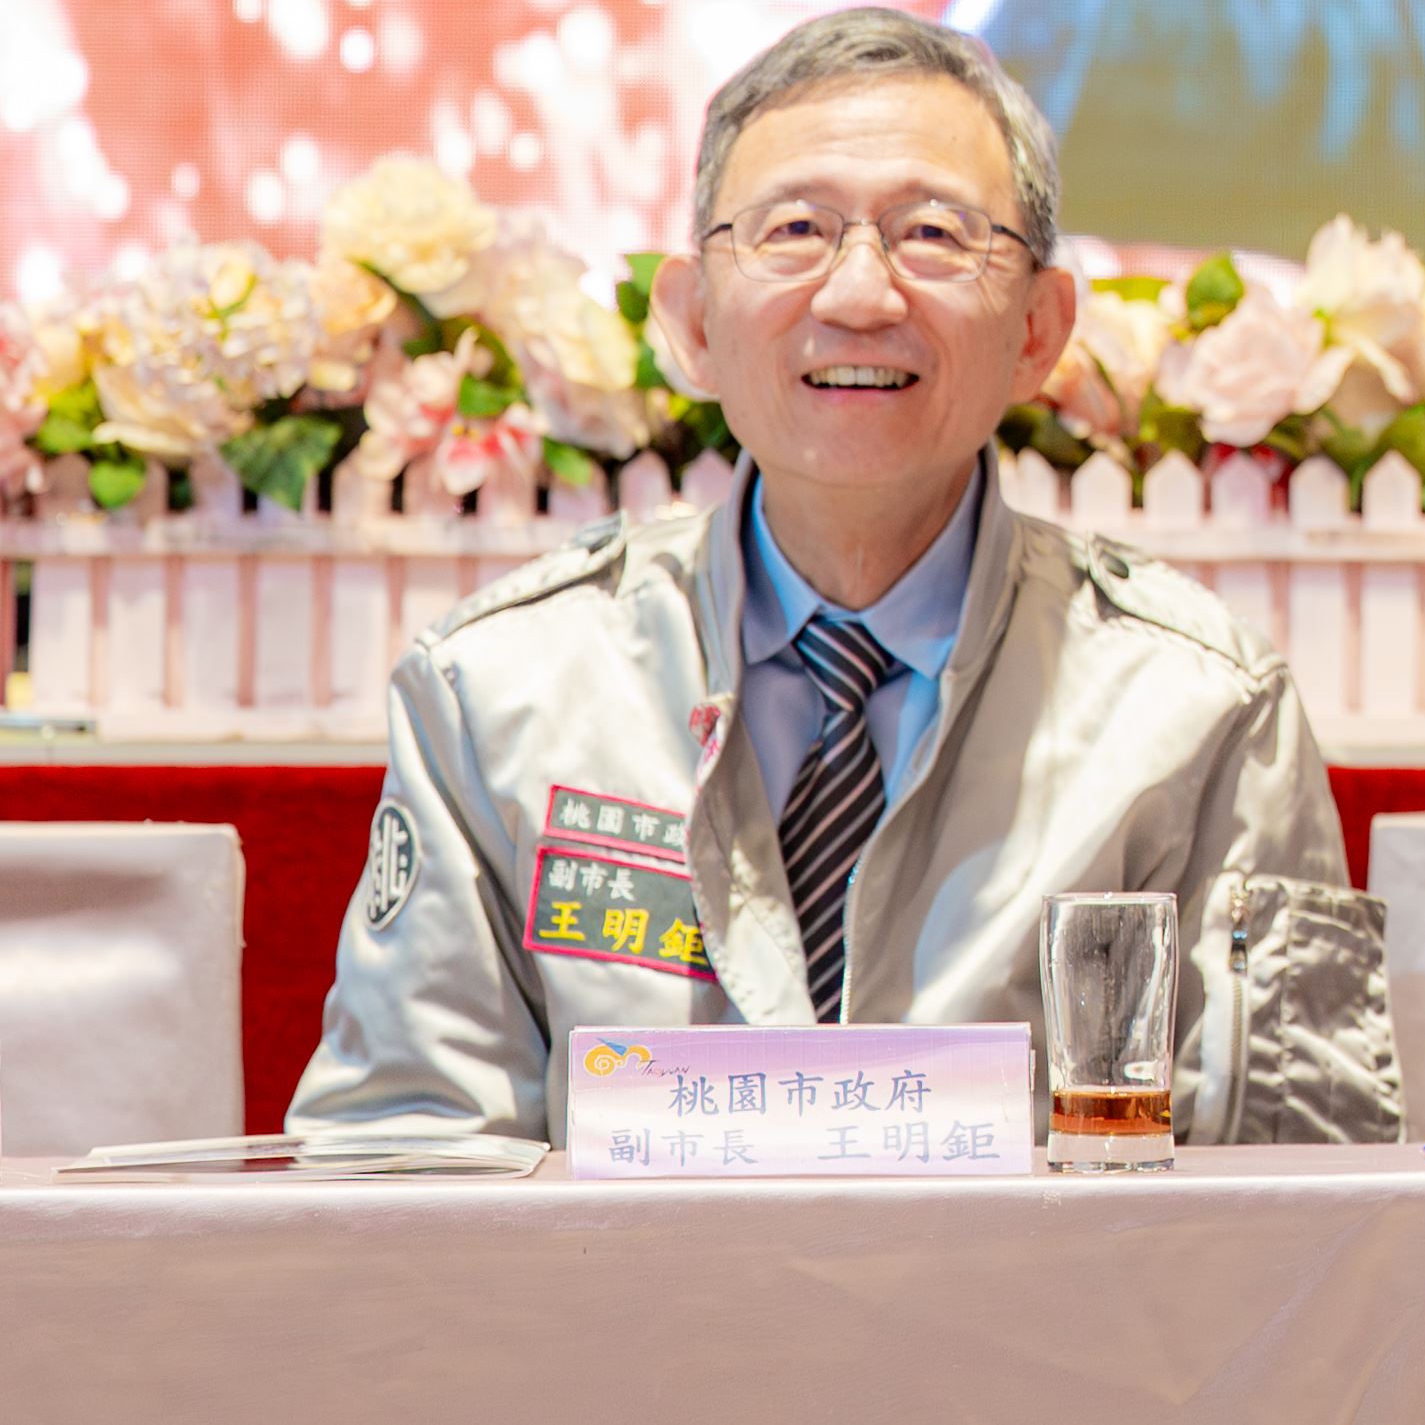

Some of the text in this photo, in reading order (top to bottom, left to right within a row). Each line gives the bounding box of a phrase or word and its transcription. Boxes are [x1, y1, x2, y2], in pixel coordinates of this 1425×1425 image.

[548, 859, 636, 902] 副市長
[538, 900, 709, 966] 王明鉅
[668, 1069, 932, 1119] 桃園市政府
[607, 1119, 1002, 1167] 副市長 王明鉅
